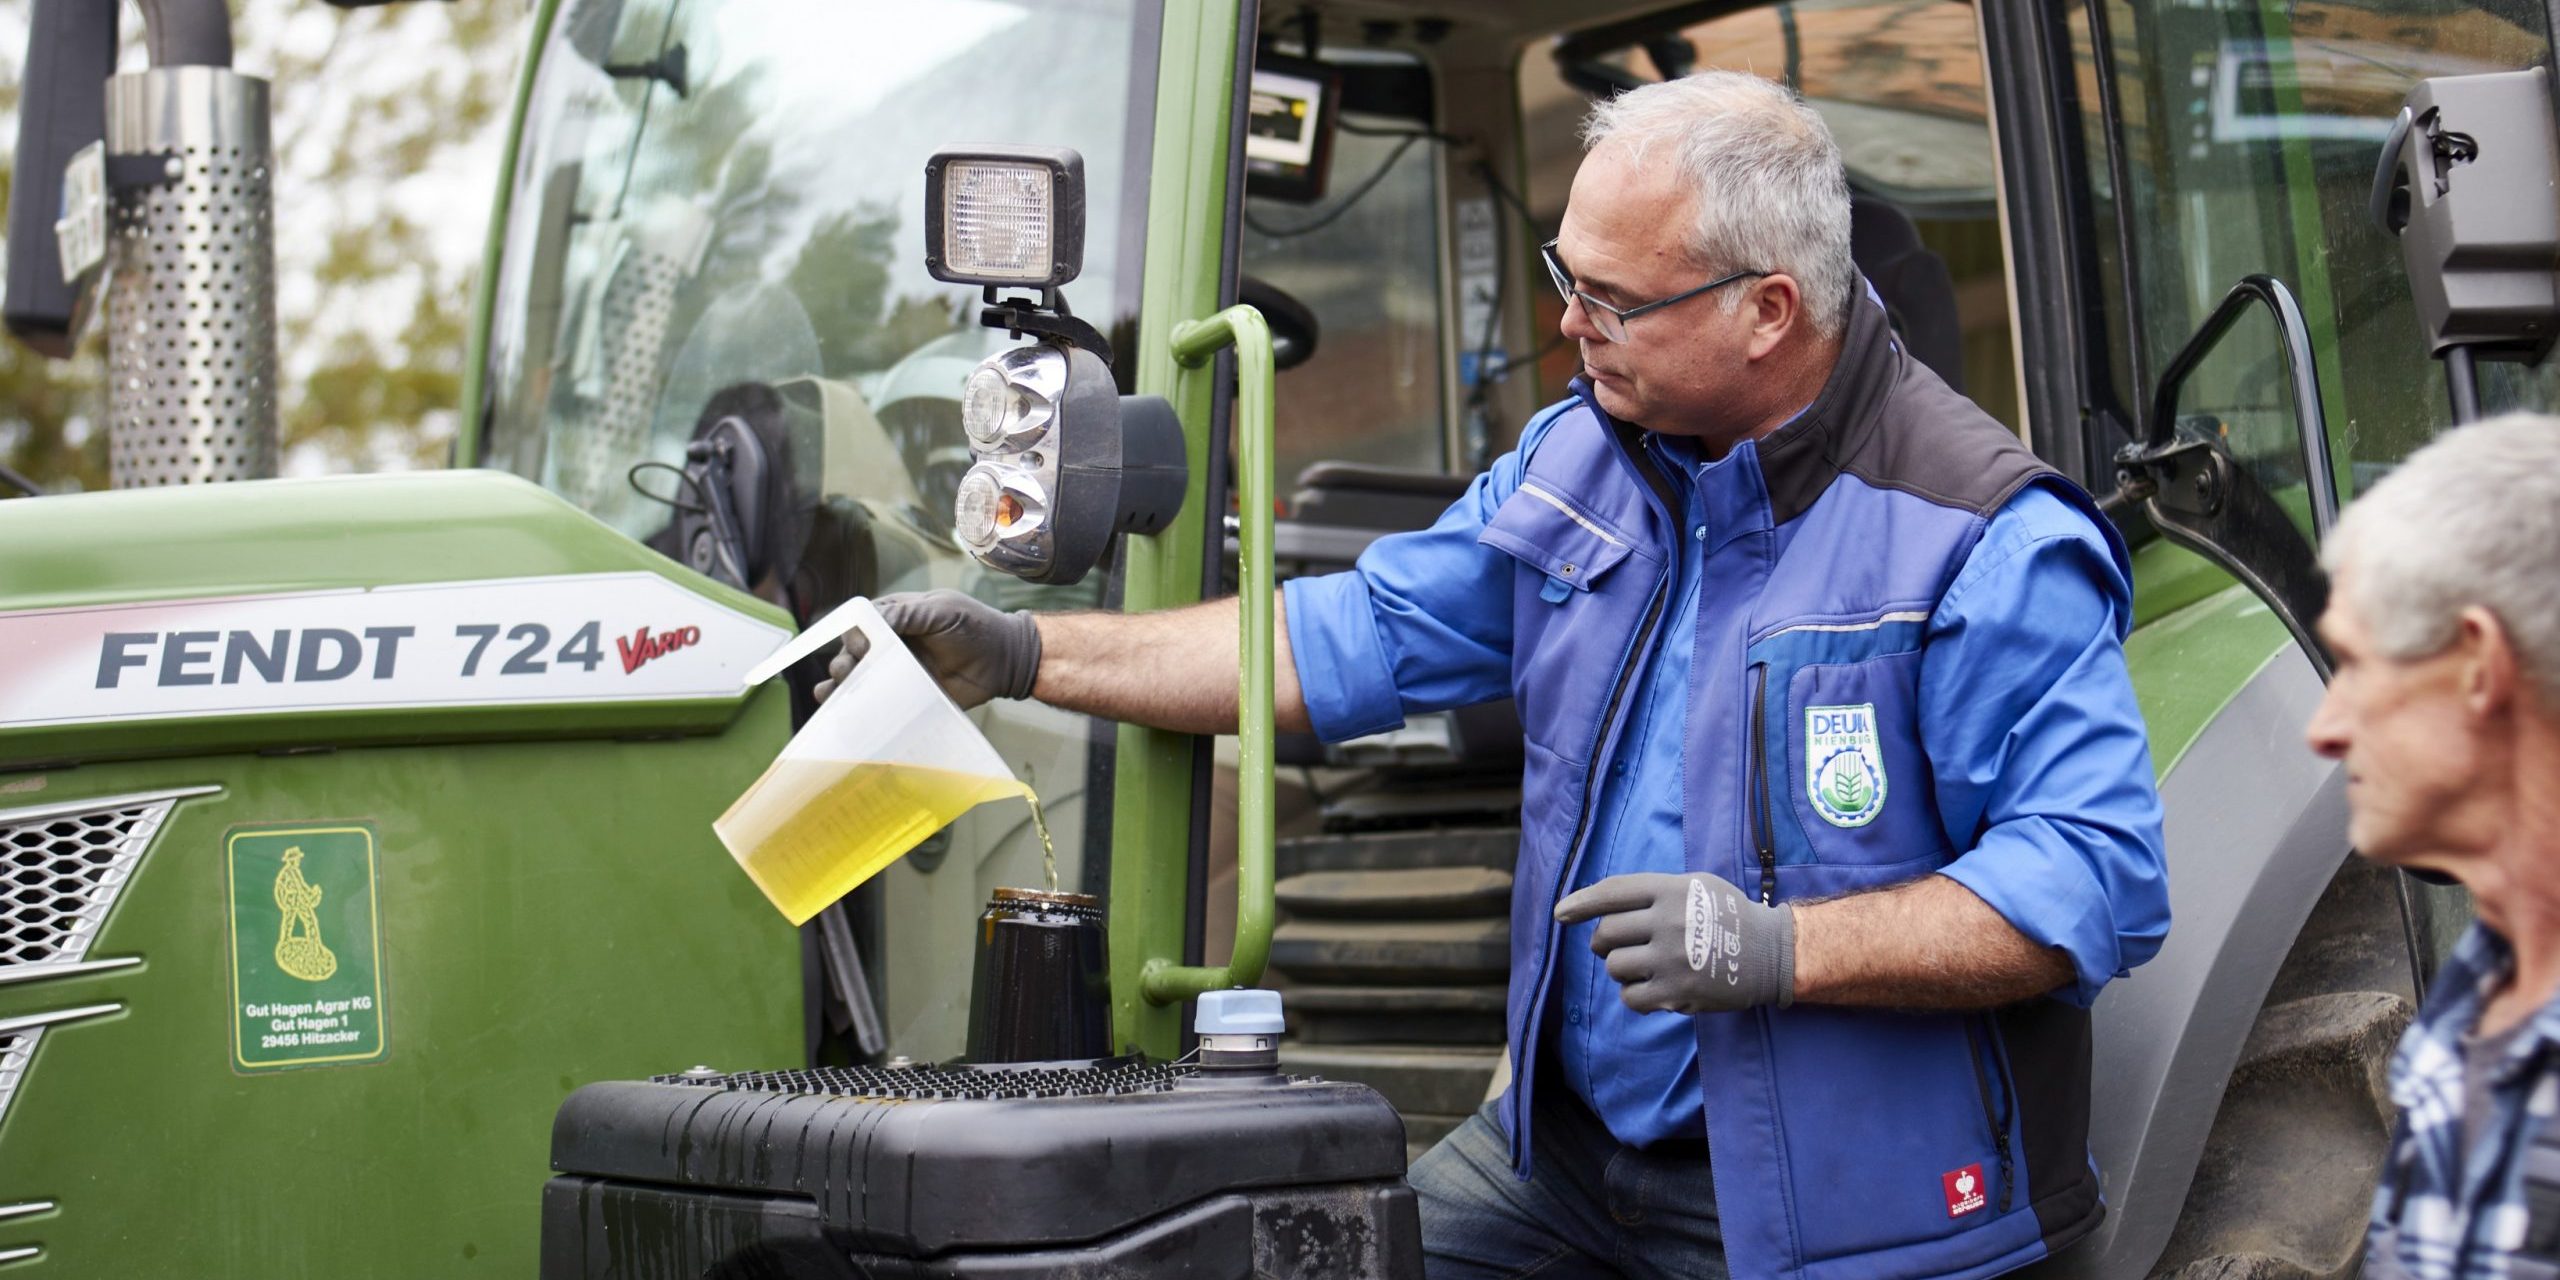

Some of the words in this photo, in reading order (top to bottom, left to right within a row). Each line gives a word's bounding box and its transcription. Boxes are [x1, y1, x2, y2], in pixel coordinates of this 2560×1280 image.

[95, 626, 416, 689] FENDT
[456, 621, 605, 677] 724
[1692, 881, 1706, 966] STRONG
[246, 1004, 269, 1017] Gut
[271, 1003, 313, 1017] Hagen
[315, 1000, 350, 1015] Agrar
[352, 996, 372, 1010] KG
[271, 1019, 296, 1032] Gut
[297, 1016, 339, 1031] Hagen
[341, 1014, 348, 1027] 1
[261, 1033, 300, 1048] 29456
[301, 1030, 360, 1045] Hitzacker
